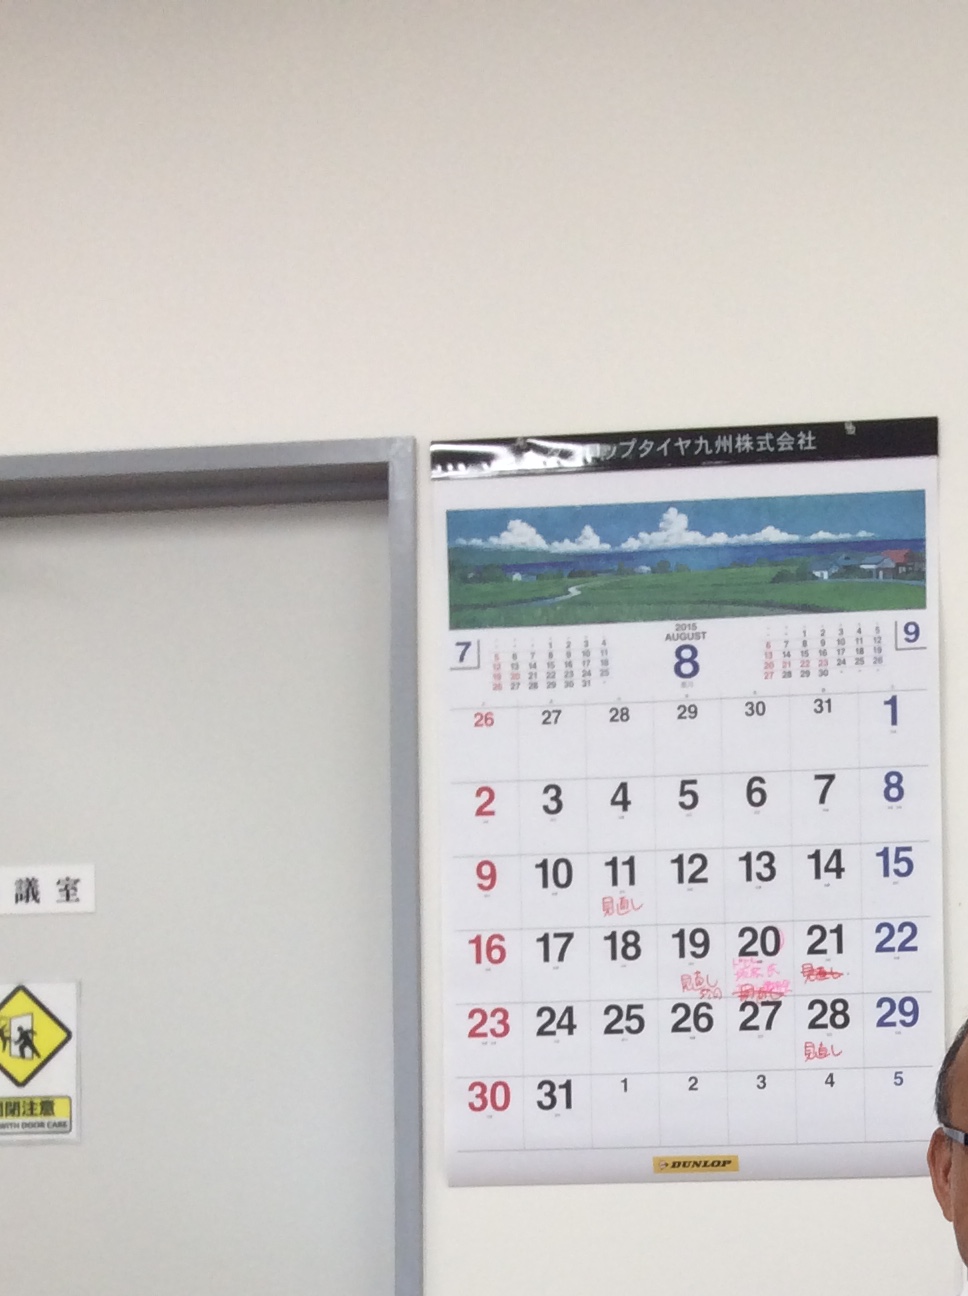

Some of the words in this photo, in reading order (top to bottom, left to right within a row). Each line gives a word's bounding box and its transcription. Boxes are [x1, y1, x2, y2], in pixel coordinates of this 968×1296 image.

[665, 631, 707, 641] AUGUST
[675, 623, 699, 633] 2015
[802, 629, 807, 638] 1
[820, 628, 826, 637] 2
[838, 627, 844, 637] 3
[856, 627, 862, 635] 4
[874, 626, 881, 635] 5
[904, 622, 920, 643] 9
[455, 641, 471, 663] 7
[674, 644, 700, 679] 8
[782, 650, 792, 659] 14
[800, 649, 810, 658] 15
[818, 648, 828, 657] 16
[836, 648, 846, 657] 17
[855, 647, 865, 656] 18
[873, 646, 883, 655] 19
[763, 671, 775, 680] 27
[781, 671, 793, 679] 28
[799, 670, 811, 678] 29
[817, 669, 829, 678] 30
[474, 712, 494, 727] 26
[542, 710, 562, 725] 27
[609, 707, 630, 722] 28
[677, 704, 698, 719] 29
[745, 701, 766, 716] 30
[814, 698, 831, 713] 31
[884, 695, 897, 726] 1
[475, 786, 495, 816] 2
[543, 784, 563, 815] 3
[611, 782, 631, 812] 4
[679, 779, 699, 810] 5
[746, 776, 767, 807] 6
[814, 774, 835, 804] 7
[884, 771, 904, 802] 8
[476, 860, 497, 891] 9
[535, 858, 573, 889] 10
[605, 856, 635, 886] 11
[671, 853, 708, 884] 12
[739, 851, 776, 882] 13
[808, 849, 845, 879] 14
[876, 846, 914, 877] 15
[469, 934, 506, 964] 16
[536, 932, 574, 962] 17
[603, 930, 641, 960] 18
[672, 928, 710, 958] 19
[738, 926, 780, 956] 20
[806, 925, 844, 954] 21
[875, 922, 918, 953] 22
[467, 1008, 510, 1038] 23
[536, 1006, 577, 1036] 24
[603, 1004, 645, 1035] 25
[671, 1002, 713, 1033] 26
[739, 1001, 782, 1031] 27
[807, 999, 850, 1029] 28
[876, 997, 920, 1027] 29
[468, 1081, 510, 1112] 30
[537, 1079, 572, 1110] 31
[621, 1078, 627, 1092] 1
[689, 1076, 698, 1091] 2
[757, 1075, 766, 1089] 3
[825, 1073, 835, 1087] 4
[894, 1071, 903, 1086] 5
[0, 1100, 55, 1117] 閉注意
[669, 1159, 733, 1169] DUNLOP
